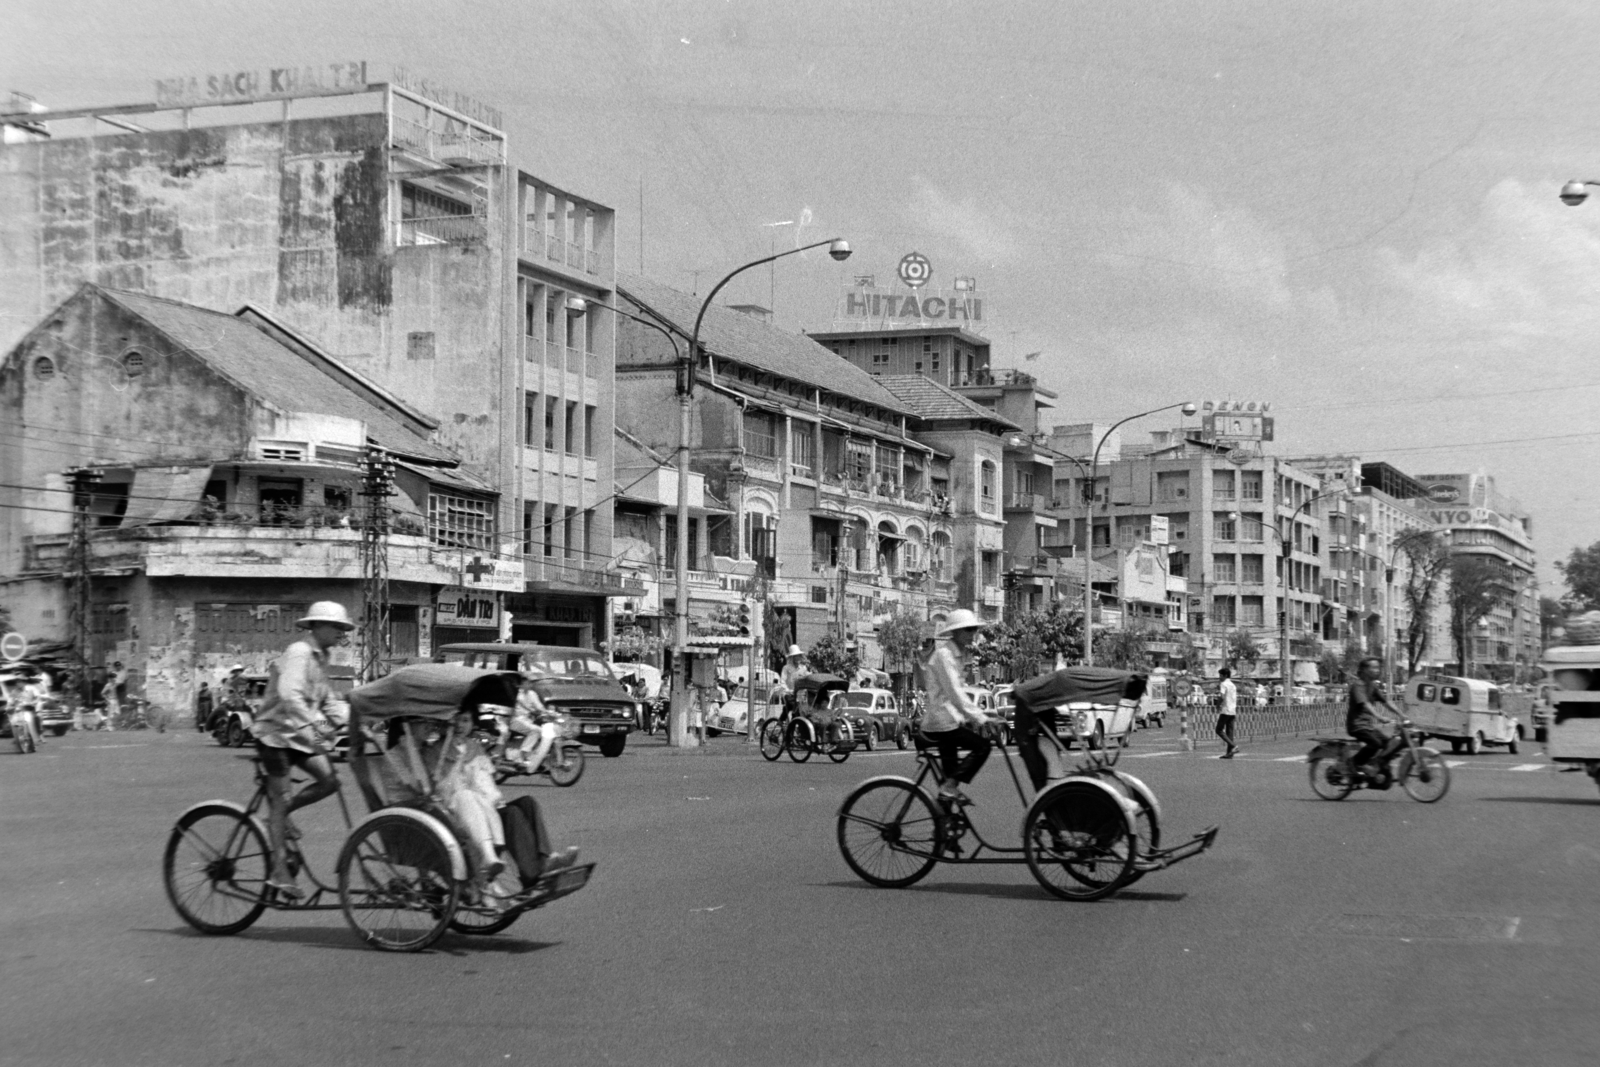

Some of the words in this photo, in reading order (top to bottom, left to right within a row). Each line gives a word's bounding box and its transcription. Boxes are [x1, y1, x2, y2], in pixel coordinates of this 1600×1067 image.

[207, 72, 260, 98] SACH
[329, 61, 367, 88] TRI
[847, 293, 982, 320] HITACHI
[1202, 400, 1271, 411] DENON
[1430, 510, 1471, 524] NYO
